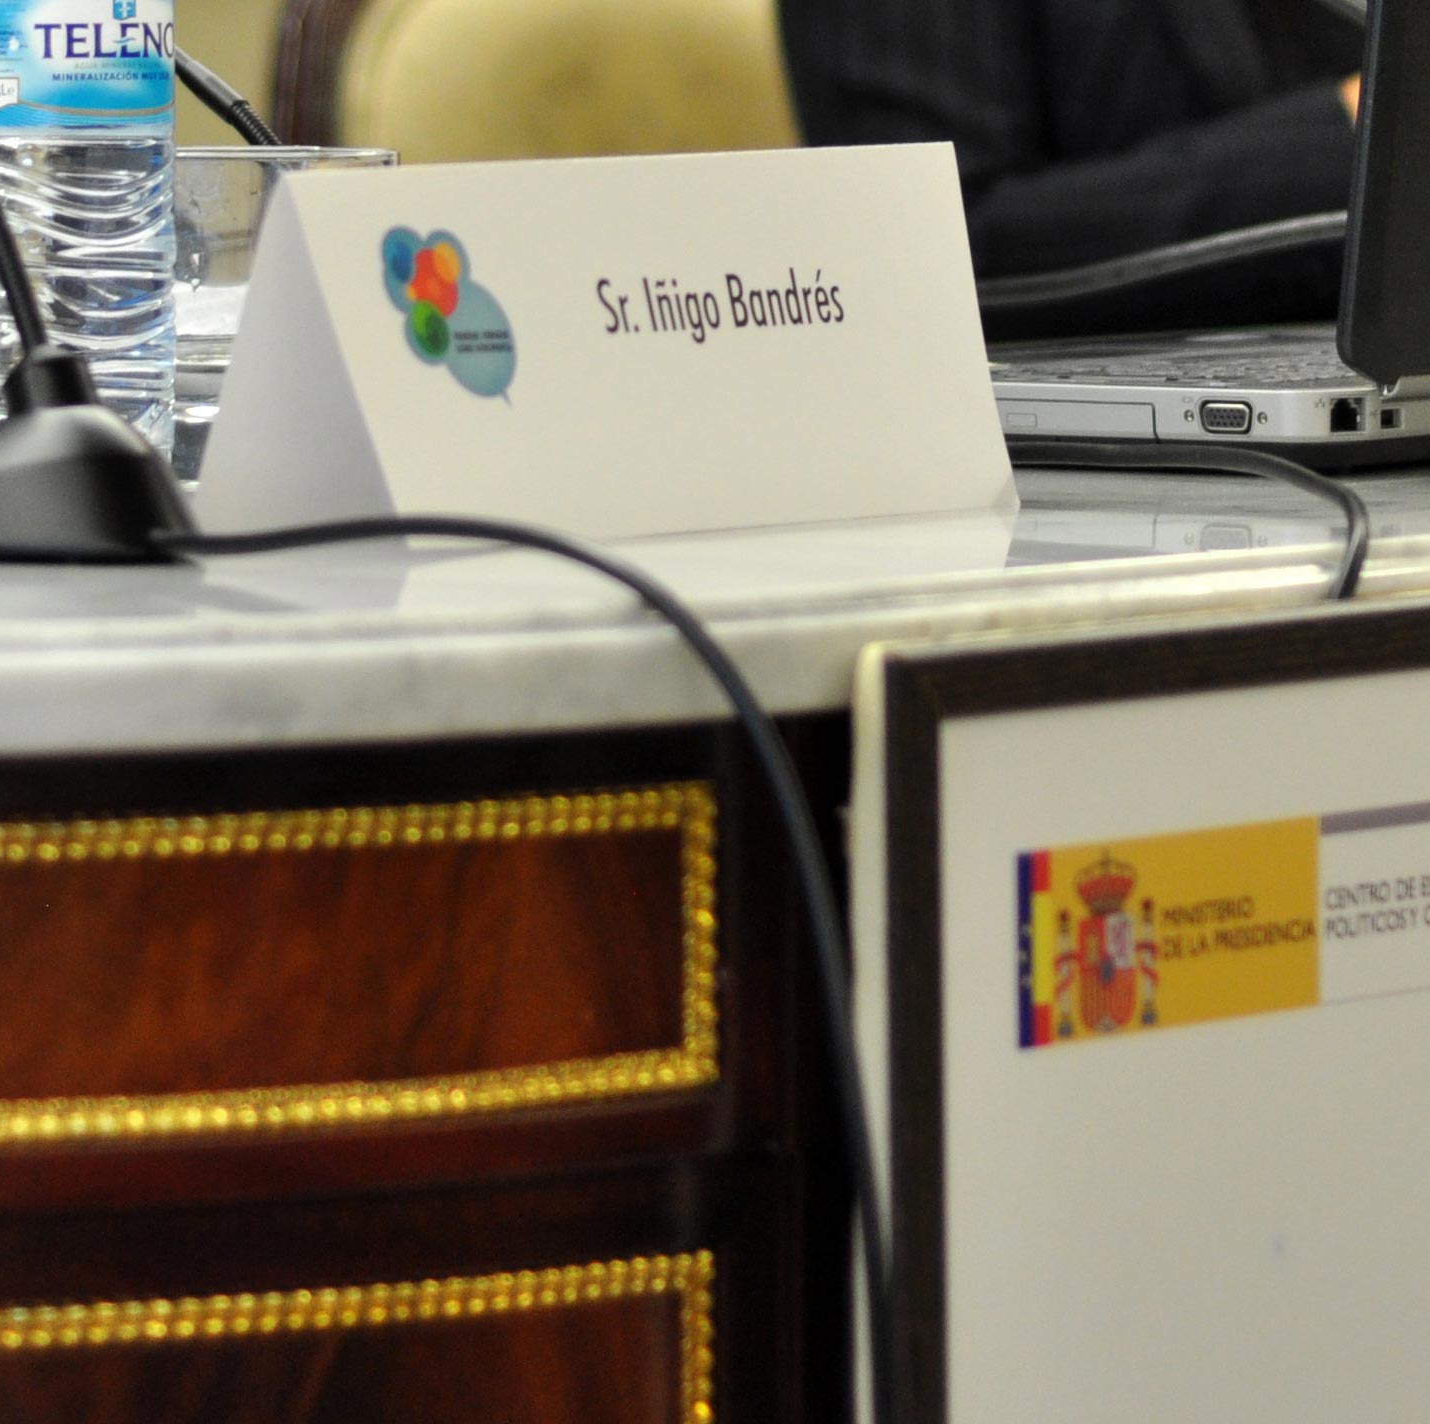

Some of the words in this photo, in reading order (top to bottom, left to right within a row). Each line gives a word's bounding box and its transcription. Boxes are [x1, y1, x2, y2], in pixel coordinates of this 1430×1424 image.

[52, 70, 139, 81] MINERALIZACIÓN
[596, 278, 640, 334] Sr.
[642, 276, 721, 344] Iñigo
[725, 267, 844, 328] Bandrés
[1326, 880, 1390, 911] CENTRO
[1395, 876, 1415, 901] DE
